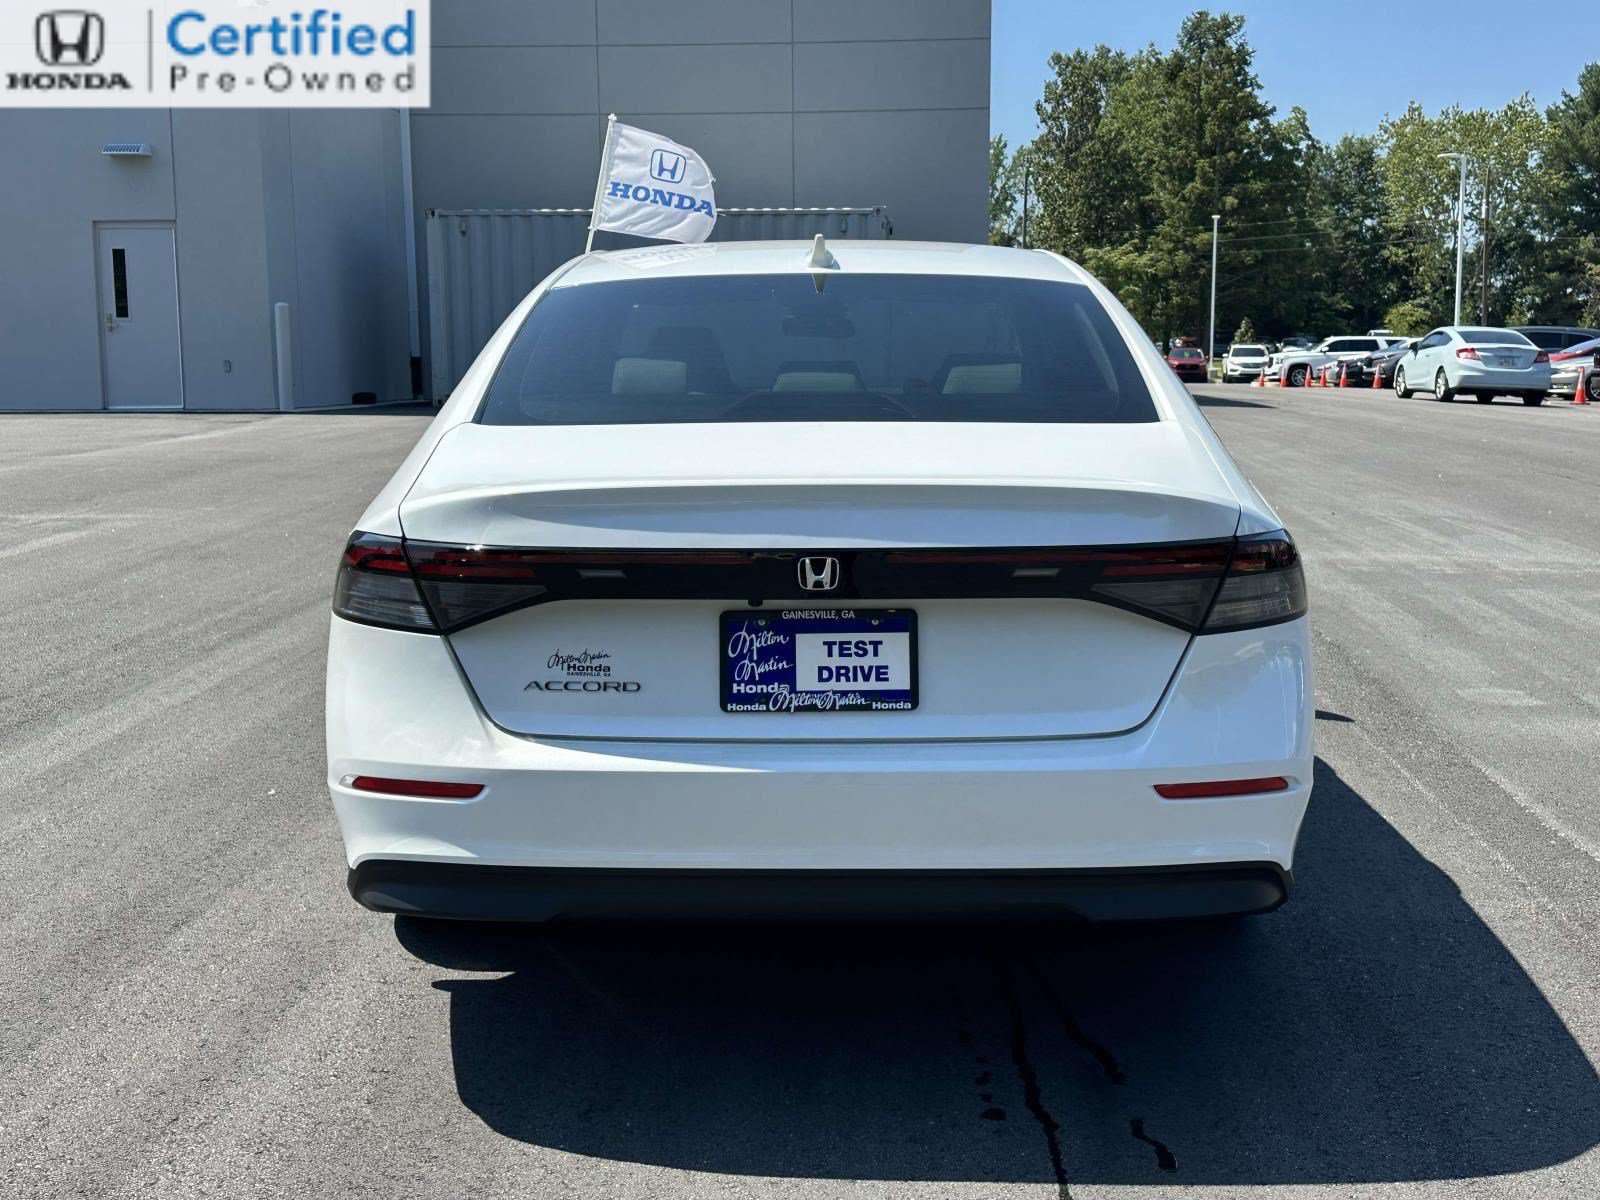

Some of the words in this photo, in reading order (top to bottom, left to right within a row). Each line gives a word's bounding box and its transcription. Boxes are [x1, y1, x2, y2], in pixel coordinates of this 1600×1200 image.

[607, 181, 715, 219] HONDA
[781, 610, 840, 621] GAINESVILLE,
[841, 610, 855, 619] GA
[728, 620, 790, 660] Milton
[822, 640, 883, 658] TEST
[566, 663, 611, 672] Honda
[734, 653, 794, 681] Martin
[817, 665, 890, 683] DRIVE
[524, 680, 641, 692] ACCORD
[732, 682, 790, 694] Honda
[727, 703, 767, 711] Honda
[769, 689, 821, 712] Milton
[818, 689, 870, 710] Martin
[872, 701, 912, 709] Honda
